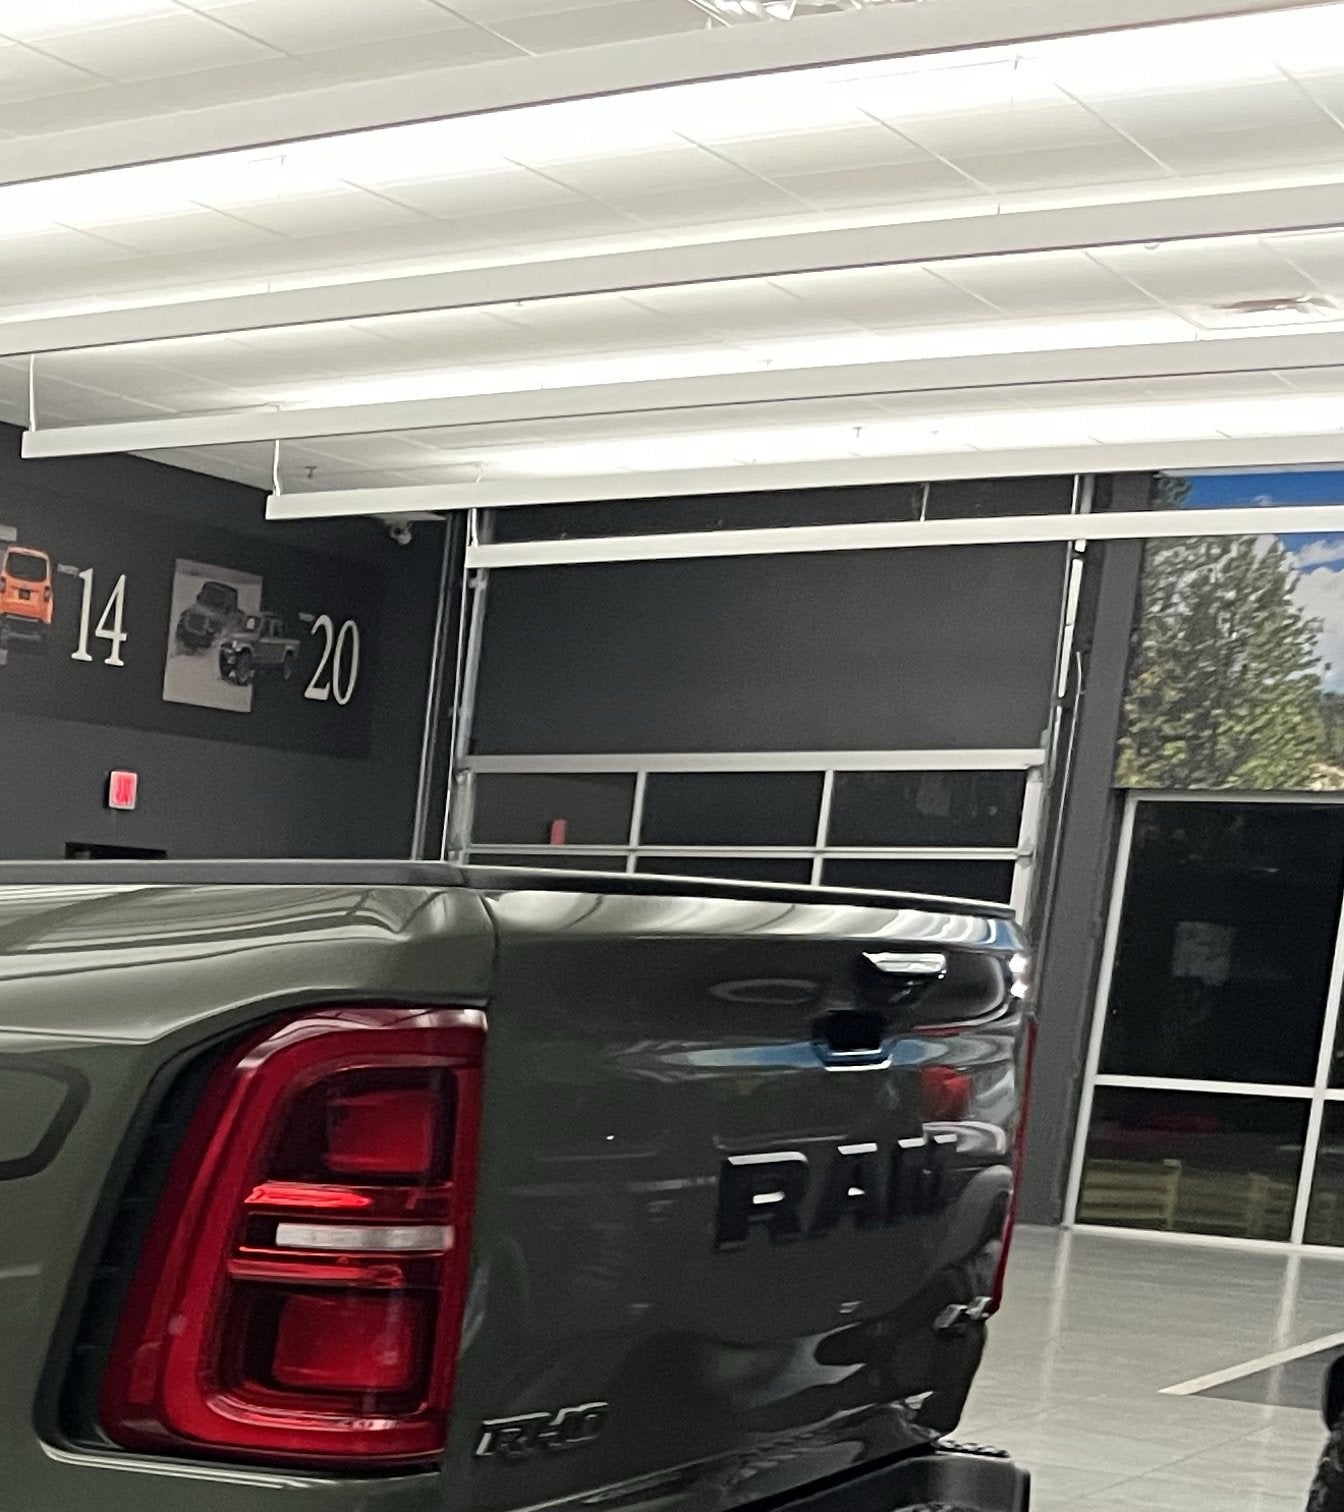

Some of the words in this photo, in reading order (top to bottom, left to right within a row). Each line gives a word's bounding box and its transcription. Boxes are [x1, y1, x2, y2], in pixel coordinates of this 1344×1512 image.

[71, 568, 128, 667] 14
[303, 614, 360, 706] 20
[715, 1133, 958, 1254] RAM
